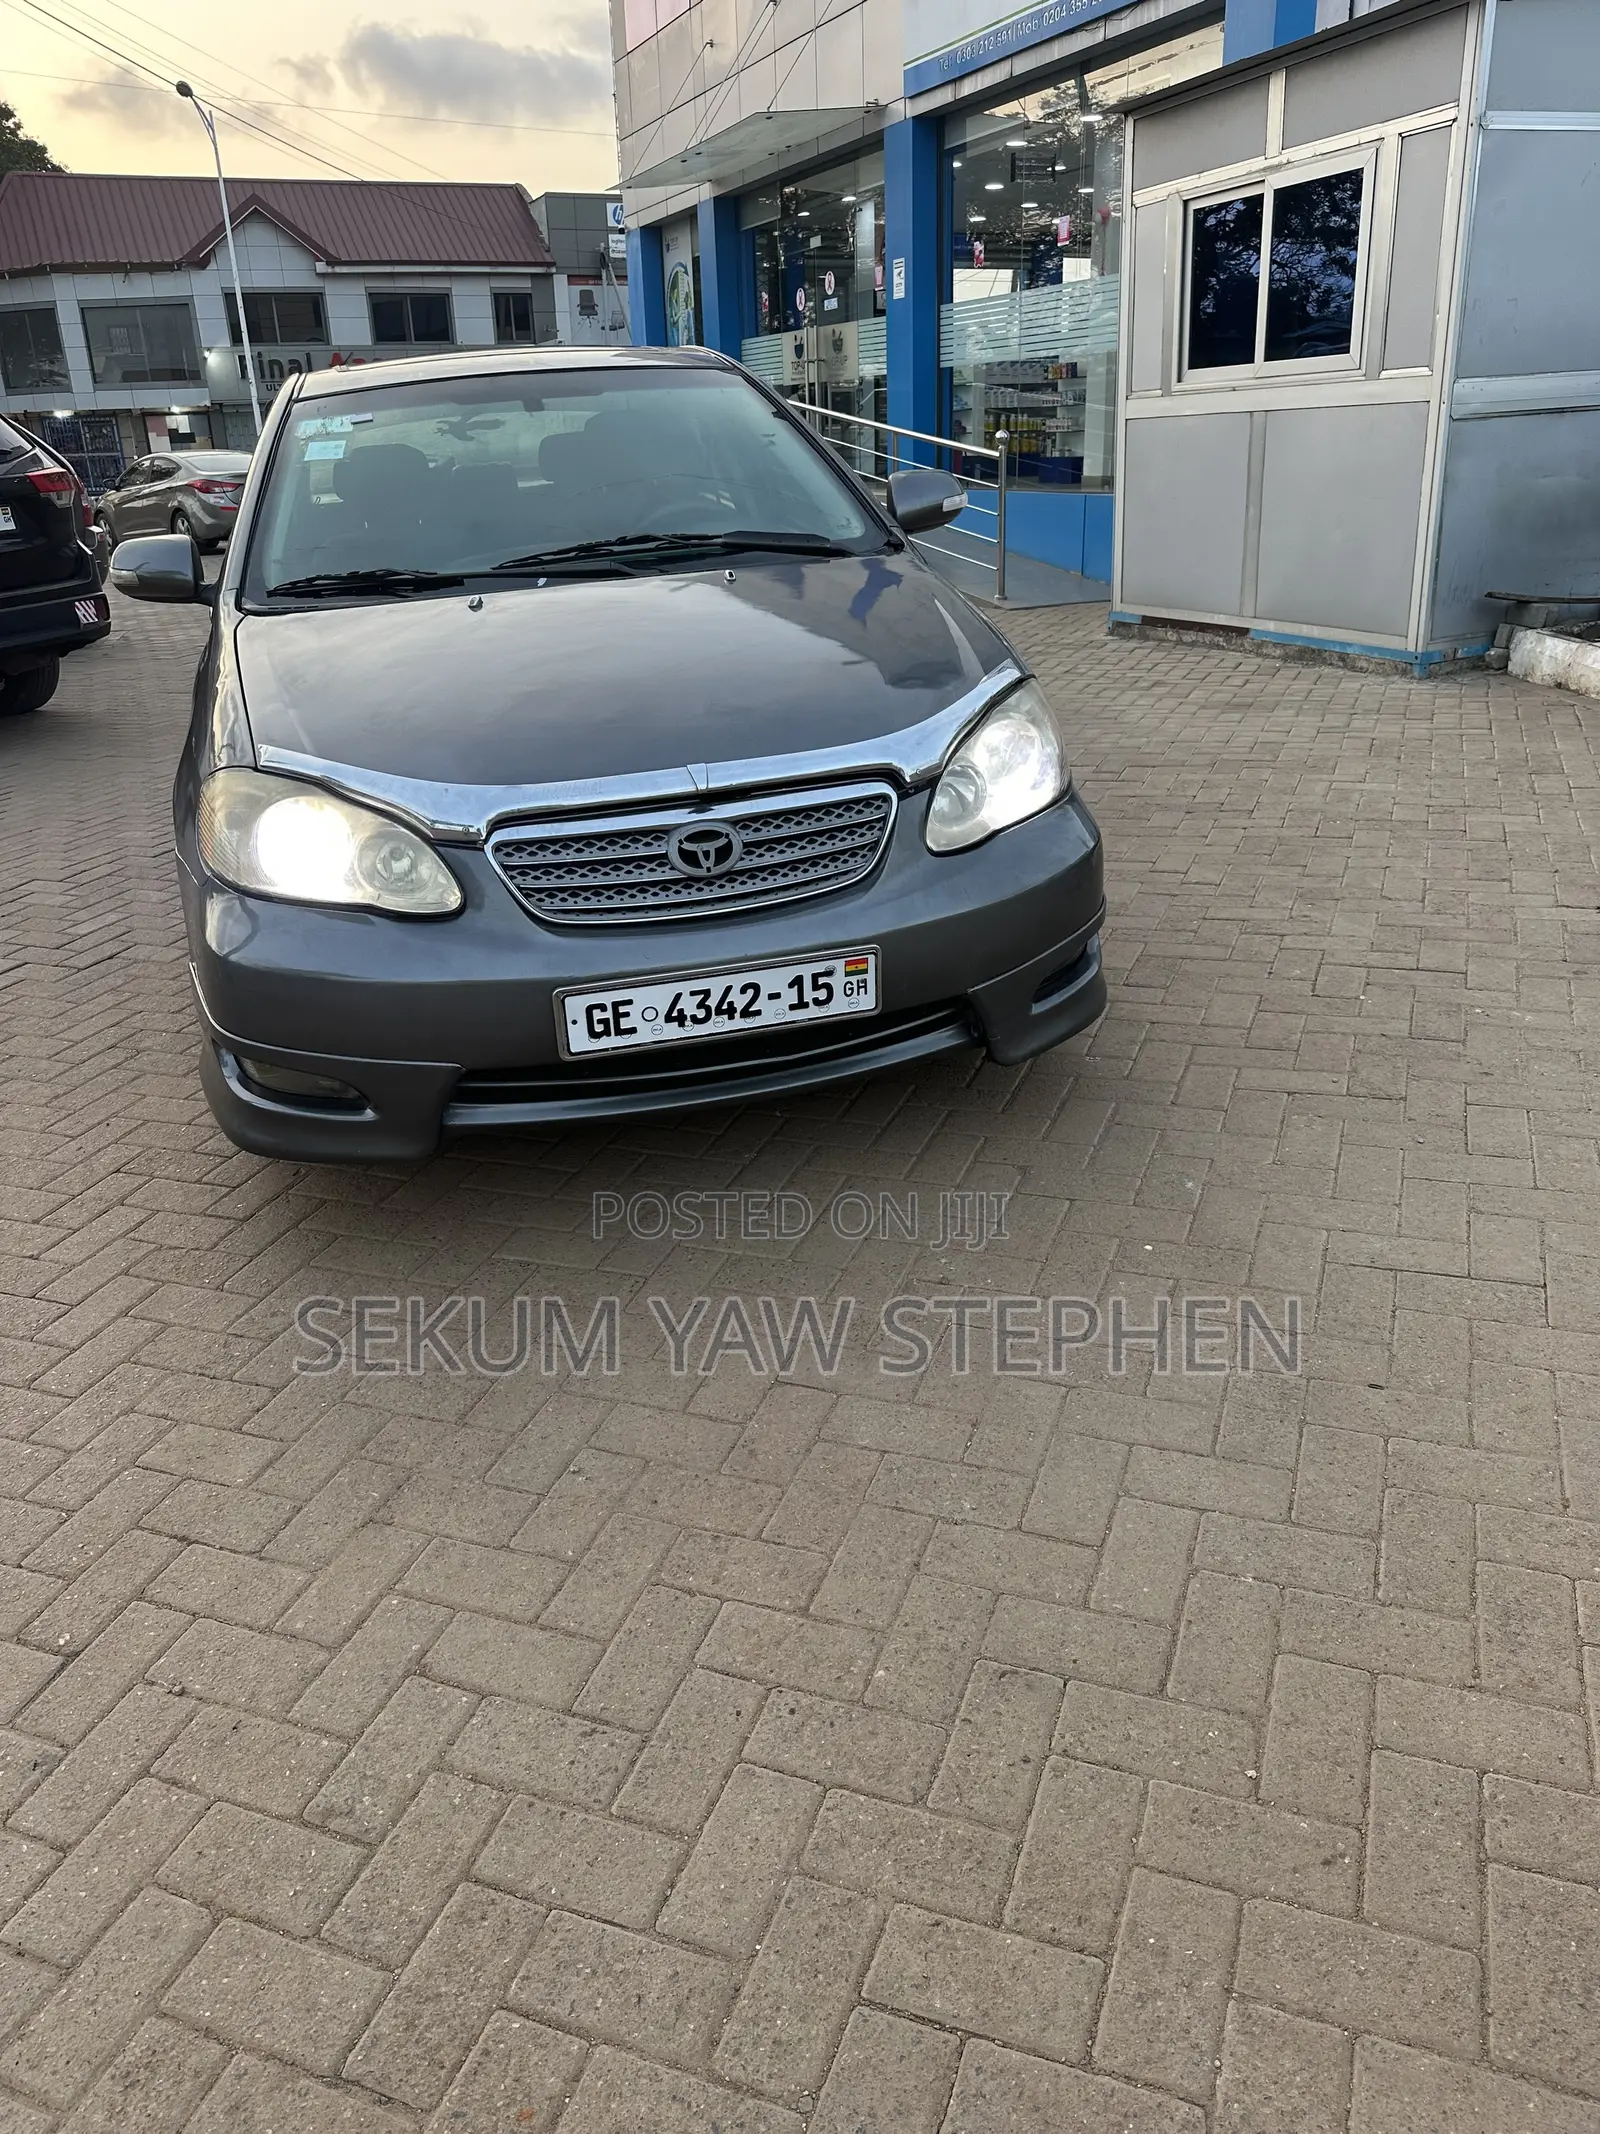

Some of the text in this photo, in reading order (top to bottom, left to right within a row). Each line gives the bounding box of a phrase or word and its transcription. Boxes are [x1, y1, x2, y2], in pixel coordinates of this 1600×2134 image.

[939, 56, 953, 70] Tel:
[956, 45, 976, 64] 0303
[978, 36, 994, 55] 212
[1043, 4, 1066, 26] 0204
[585, 971, 834, 1039] GE 4342-15
[843, 978, 868, 997] GH
